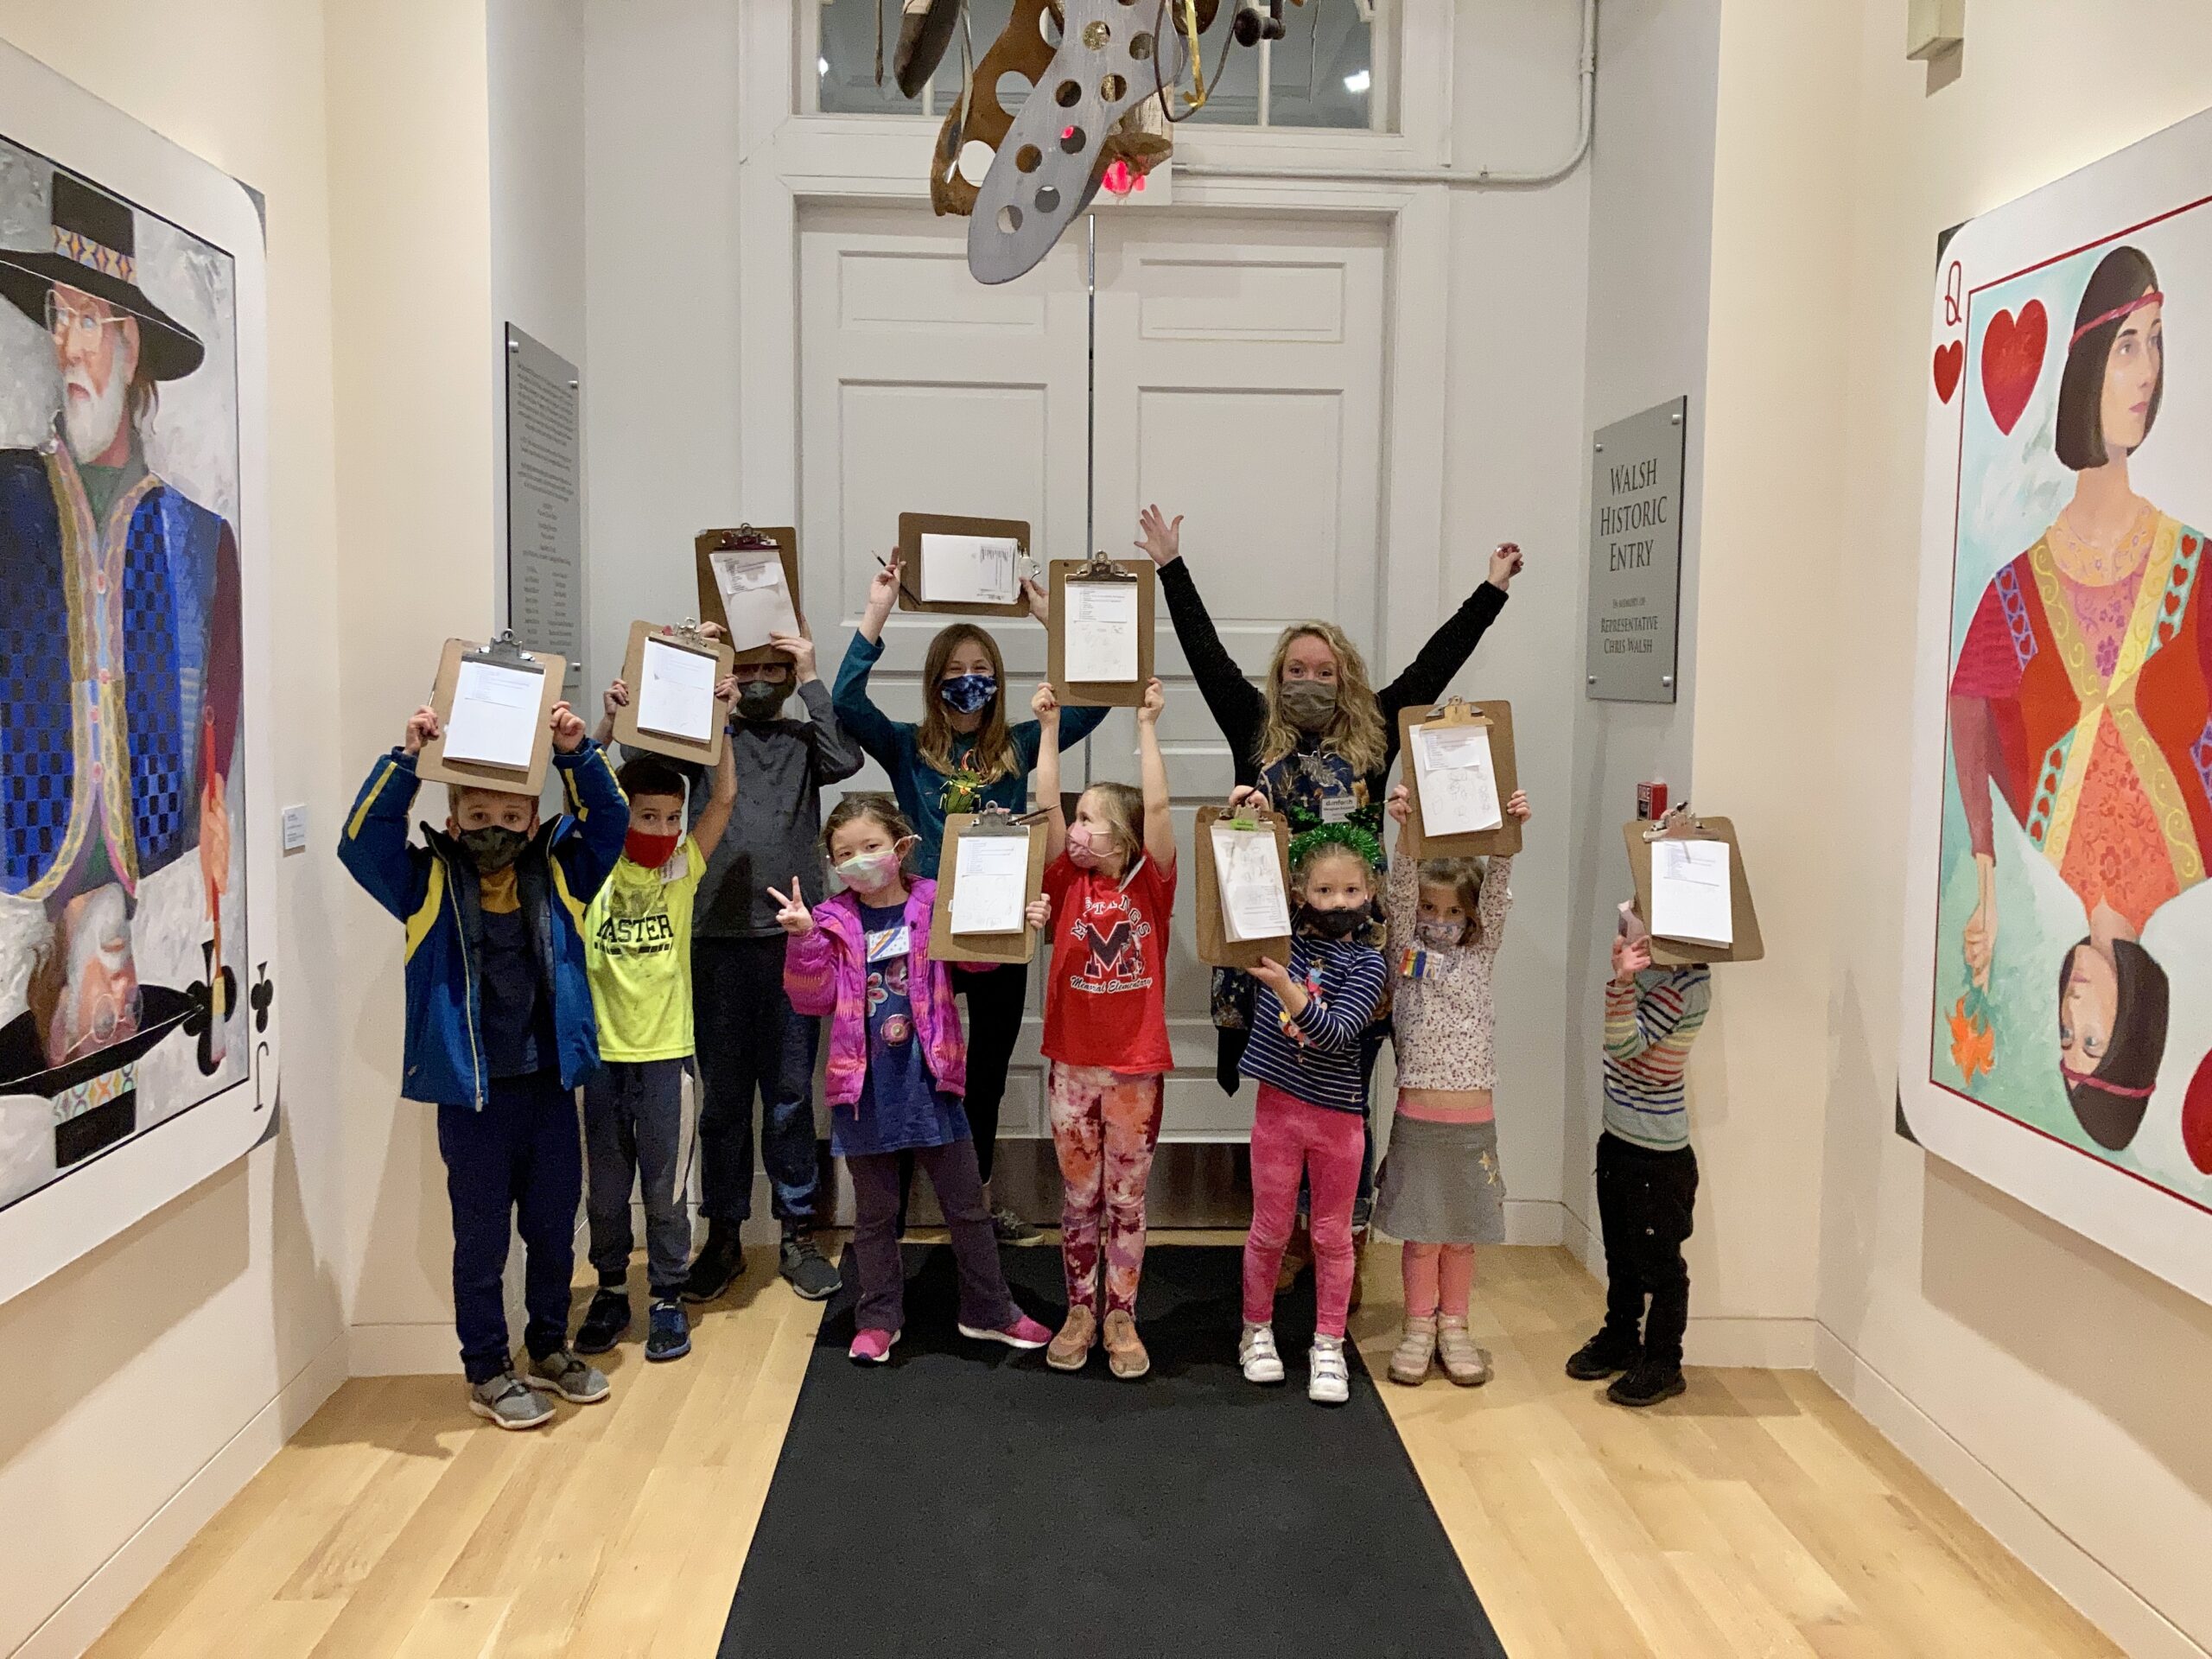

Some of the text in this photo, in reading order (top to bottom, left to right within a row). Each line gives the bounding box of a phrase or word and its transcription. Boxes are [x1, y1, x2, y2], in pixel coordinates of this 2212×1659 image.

[1944, 260, 1962, 327] Q
[1610, 458, 1657, 496] WALSH
[1600, 496, 1668, 537] HISTORIC
[1609, 539, 1655, 572] ENTRY
[1600, 615, 1659, 633] REPRESENTATIVE
[1604, 638, 1653, 654] CHRIS WALSH
[1107, 976, 1153, 993] Elementary
